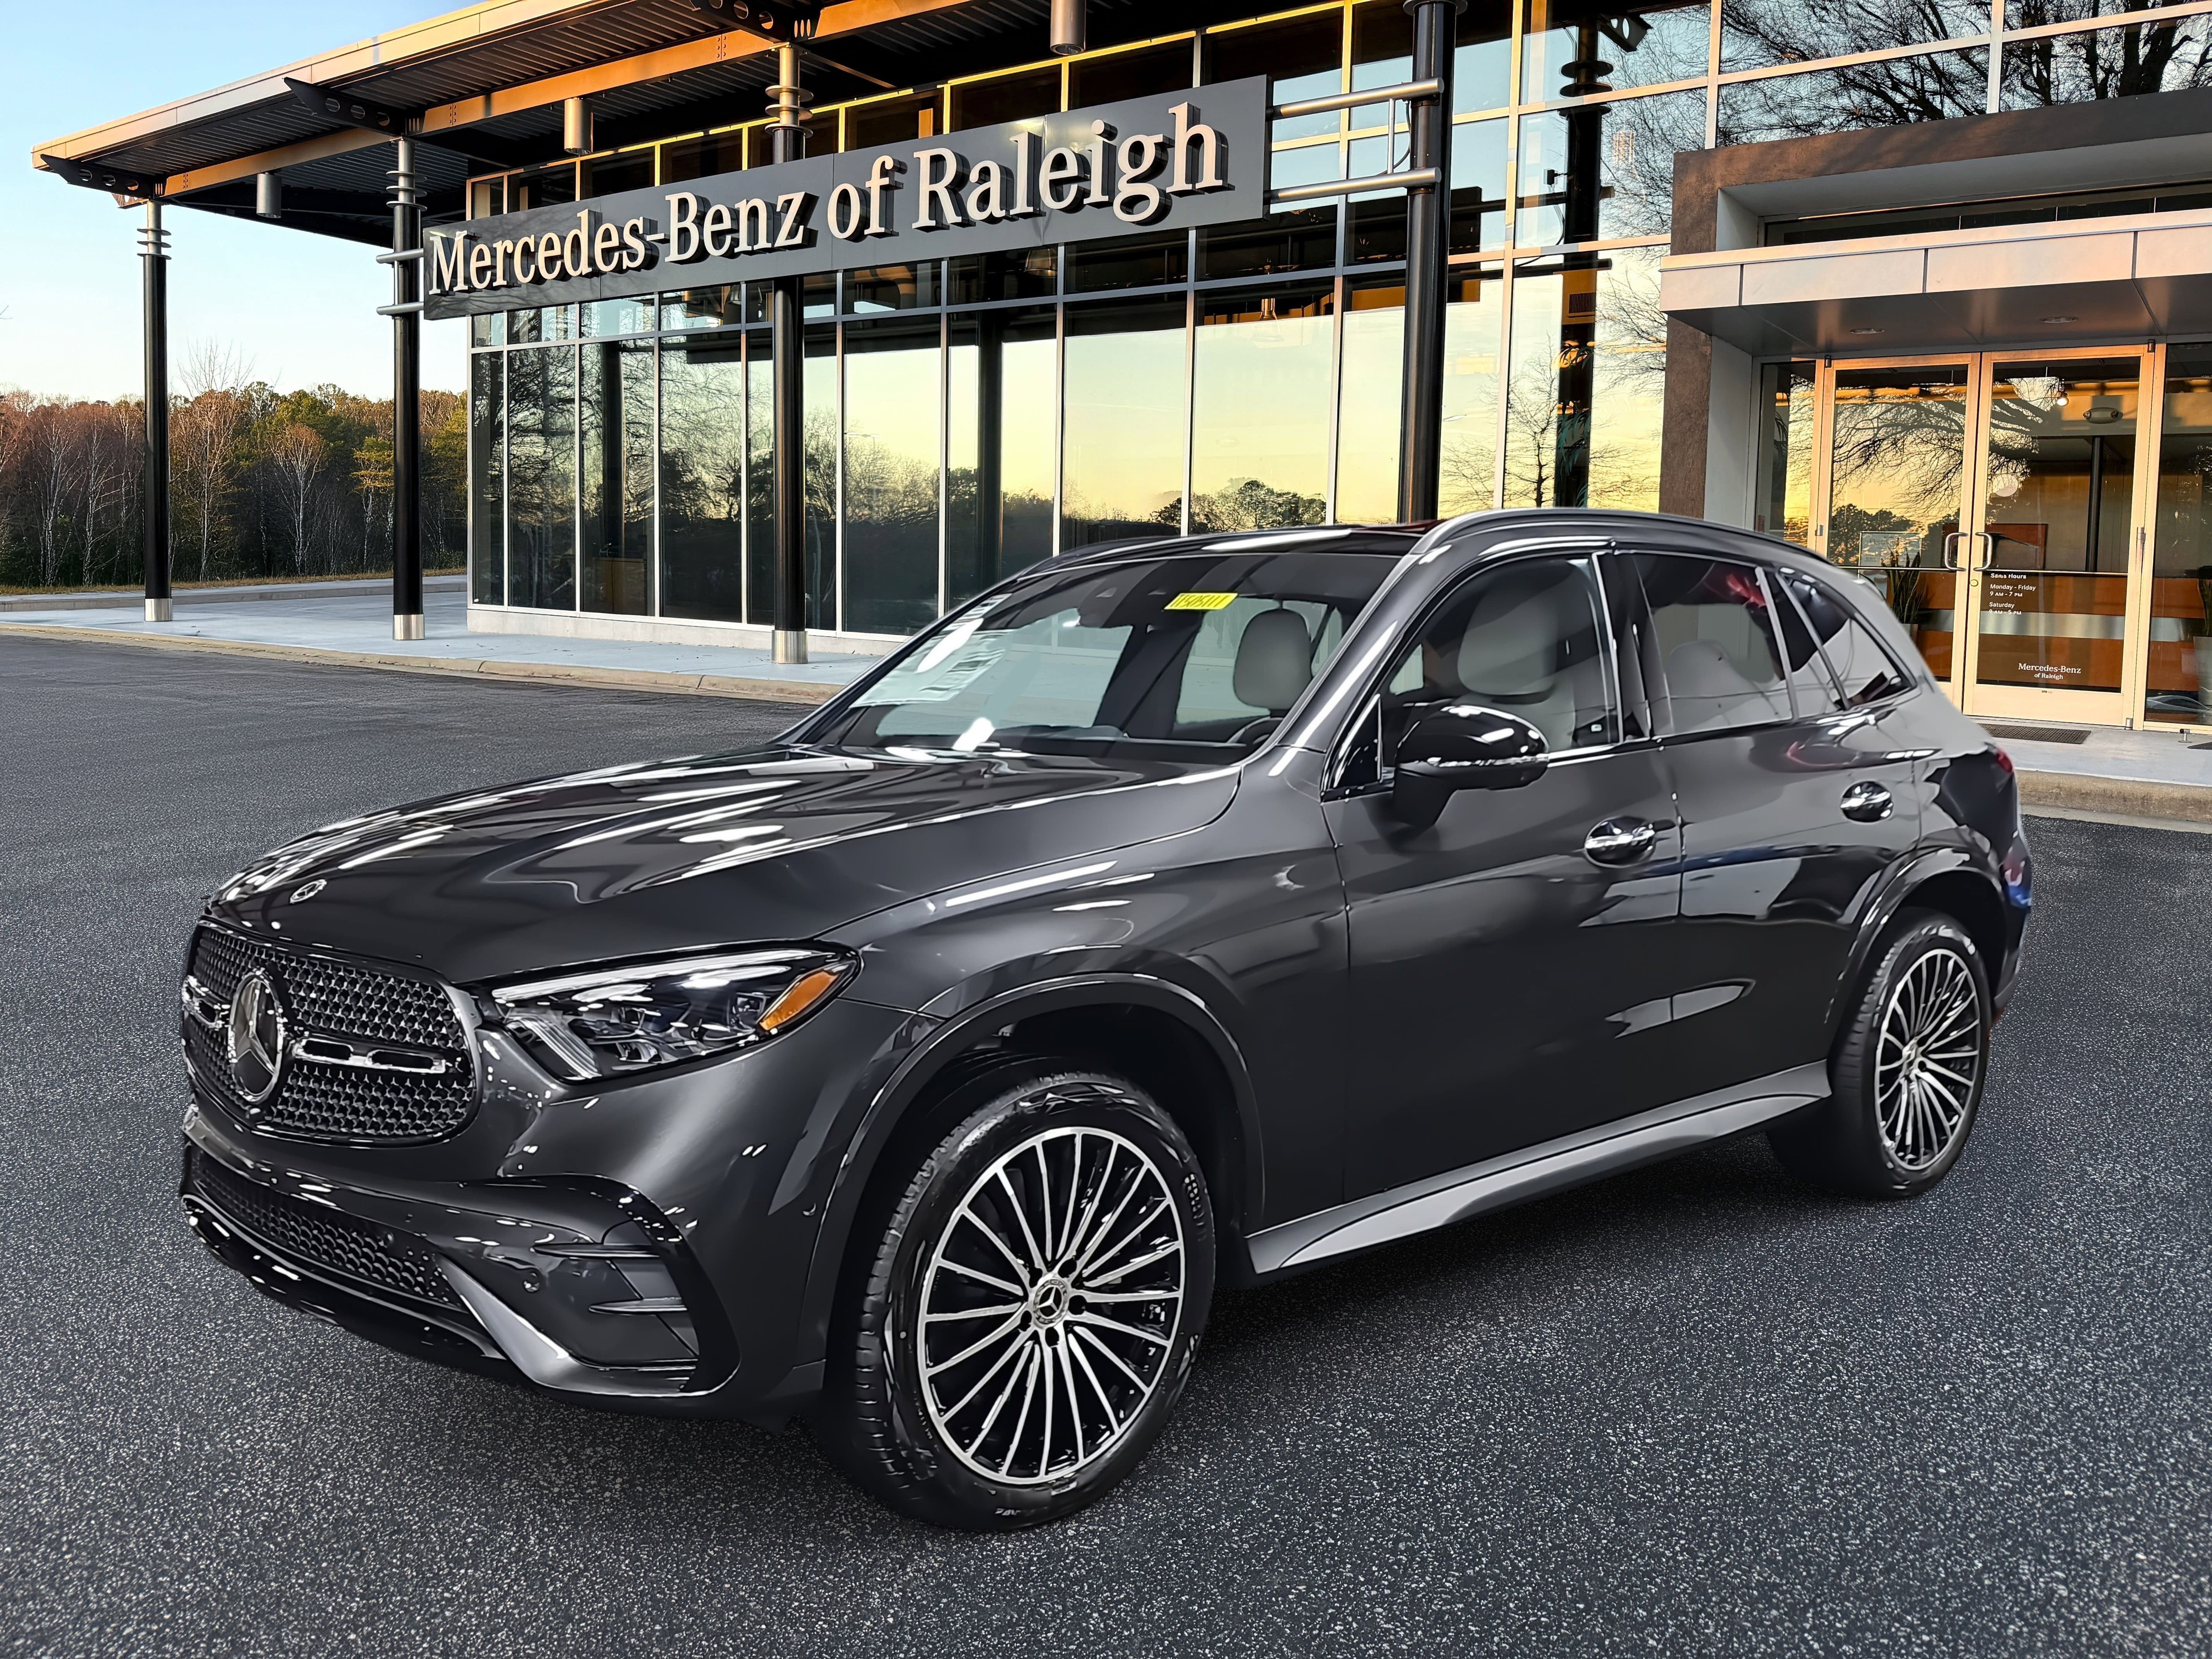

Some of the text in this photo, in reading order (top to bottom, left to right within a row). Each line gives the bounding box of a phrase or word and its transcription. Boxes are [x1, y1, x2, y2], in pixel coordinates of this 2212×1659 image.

[428, 101, 1223, 295] Mercedes-Benz of Raleigh
[2018, 663, 2081, 674] Mercedes-Benz
